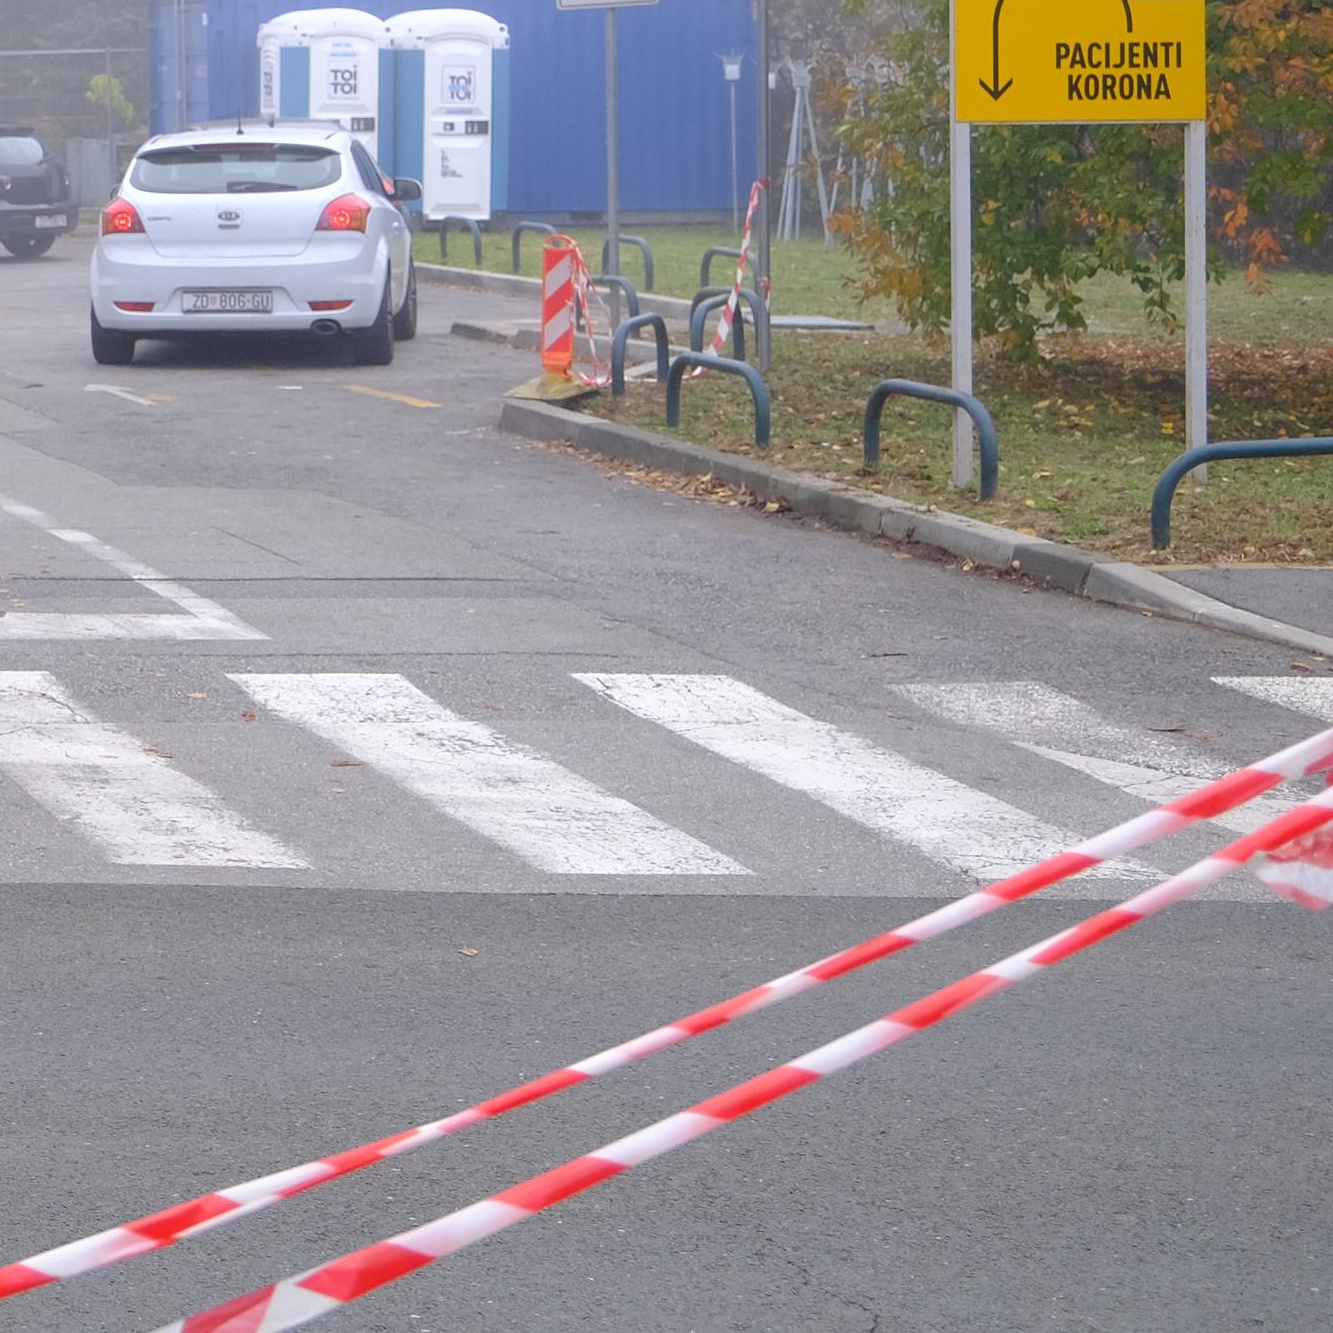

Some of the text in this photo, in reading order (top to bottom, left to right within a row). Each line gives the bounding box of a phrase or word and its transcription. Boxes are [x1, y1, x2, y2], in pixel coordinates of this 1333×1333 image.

[1055, 42, 1182, 69] PACIJENTI
[330, 82, 357, 95] TOI
[1067, 73, 1172, 101] KORONA
